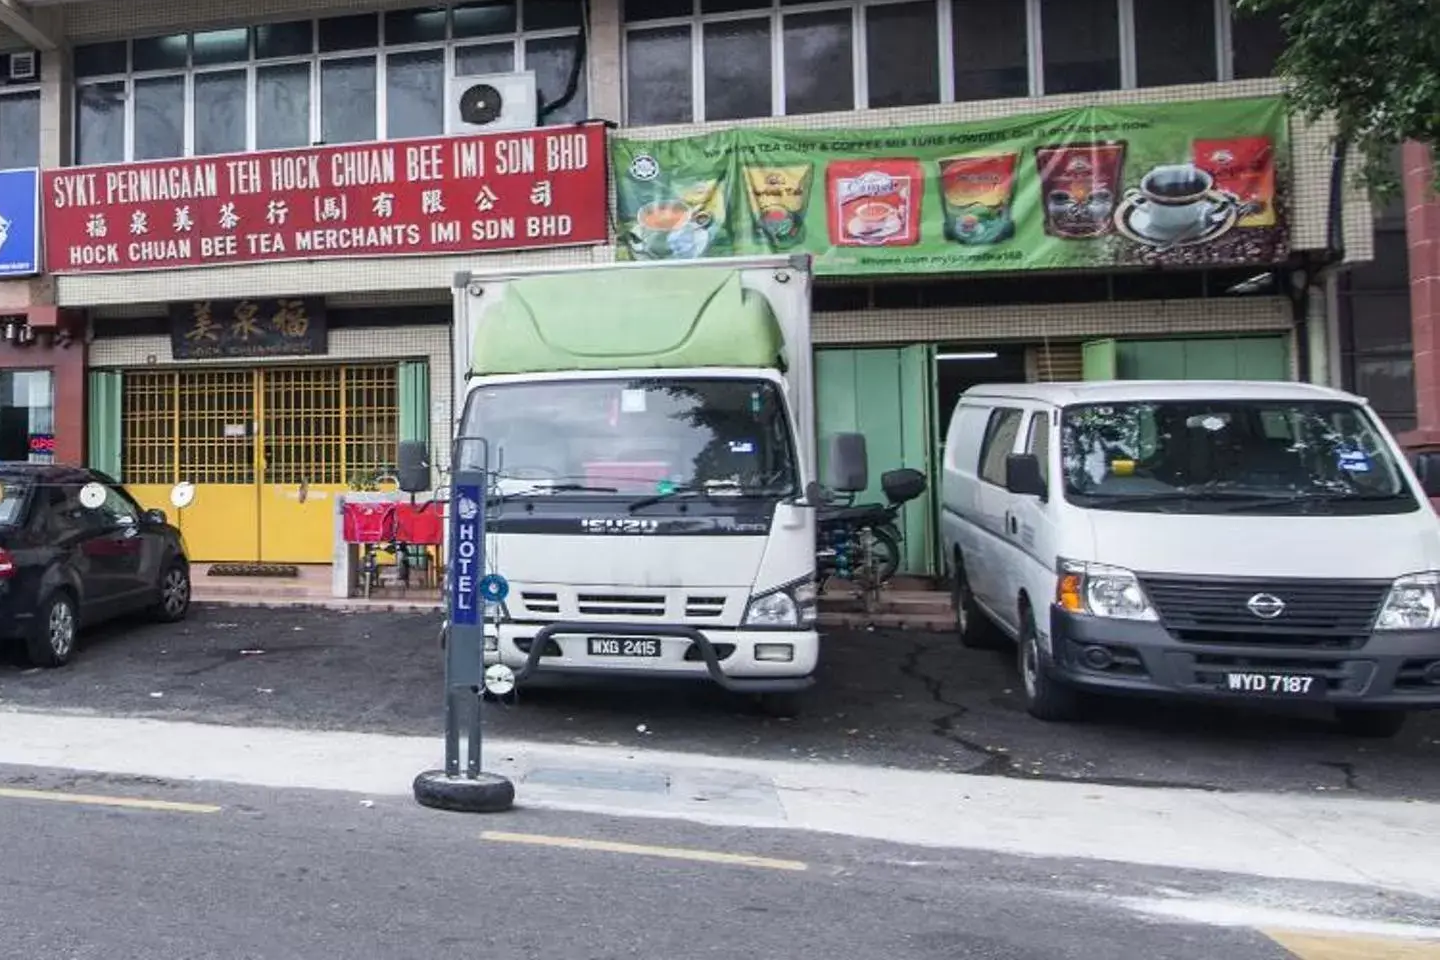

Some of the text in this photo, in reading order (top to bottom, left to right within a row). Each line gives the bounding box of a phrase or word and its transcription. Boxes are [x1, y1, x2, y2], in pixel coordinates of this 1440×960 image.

[53, 172, 101, 209] SYKT.
[107, 164, 217, 205] PERNIAGAAN
[226, 159, 261, 195] TEH
[271, 155, 320, 190] HOCK
[331, 147, 395, 187] CHUAN
[406, 143, 443, 181] BEE
[495, 136, 534, 174] SDN
[546, 133, 588, 172] BHD
[70, 244, 119, 265] HOCK
[127, 240, 192, 261] CHUAN
[201, 236, 237, 257] BEE
[247, 233, 285, 254] TEA
[295, 224, 420, 251] MERCHANTS
[471, 217, 515, 240] SDN
[526, 215, 572, 238] BHD
[581, 519, 659, 533] ISUZU
[458, 524, 475, 610] HOTEL
[623, 639, 656, 654] 2415
[1228, 673, 1313, 693] WYD 7187
